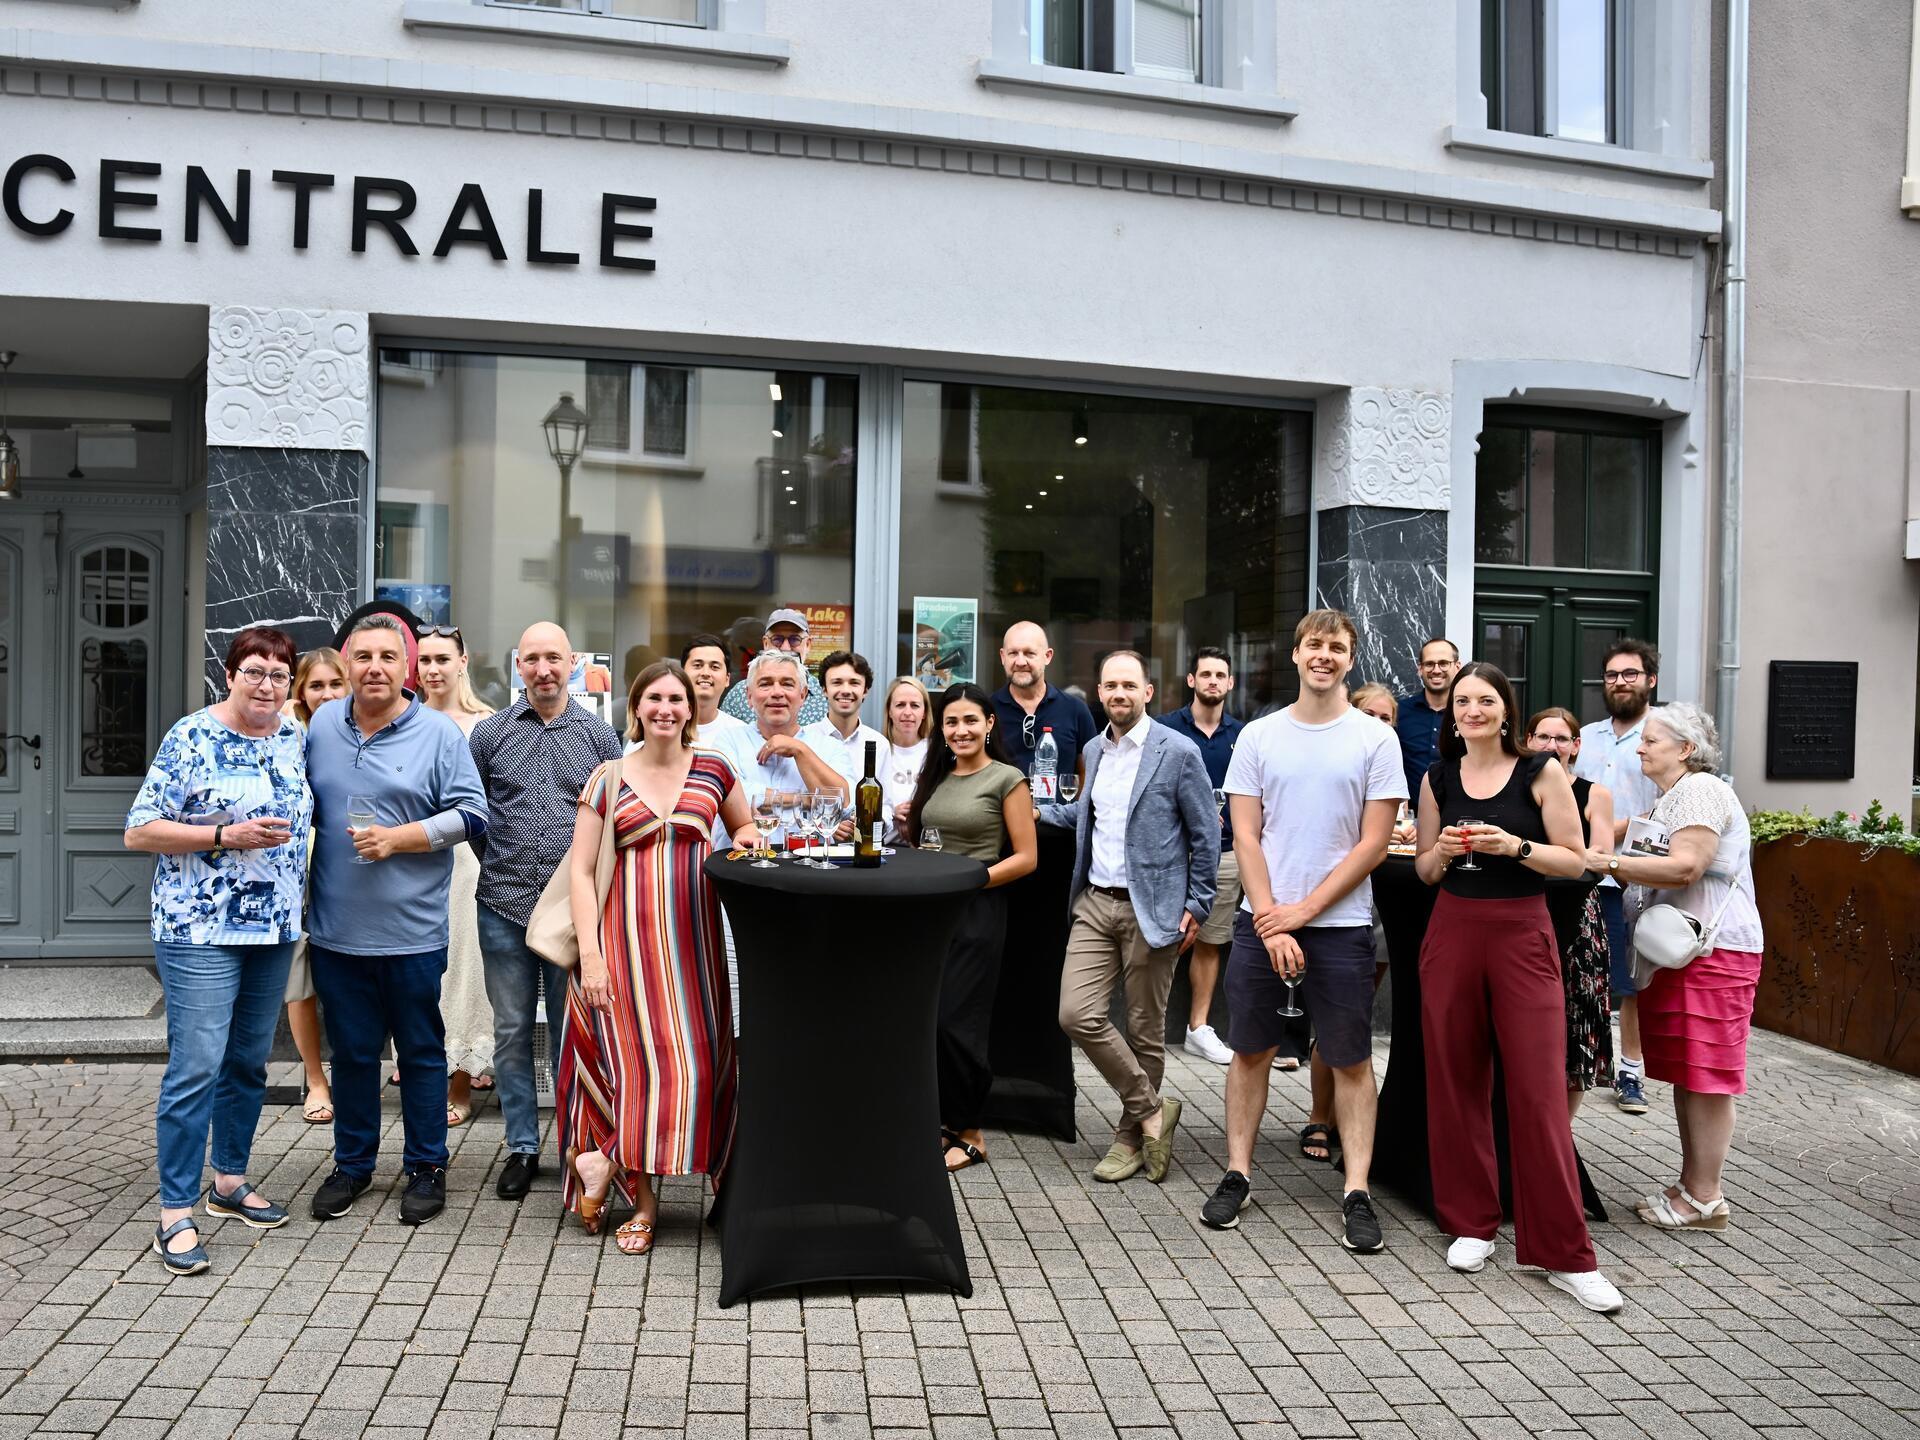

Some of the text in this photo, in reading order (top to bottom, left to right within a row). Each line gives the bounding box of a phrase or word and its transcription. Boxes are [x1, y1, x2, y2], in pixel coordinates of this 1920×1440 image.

[3, 153, 657, 272] CENTRALE
[806, 607, 846, 622] Lake
[1658, 832, 1670, 846] Ta
